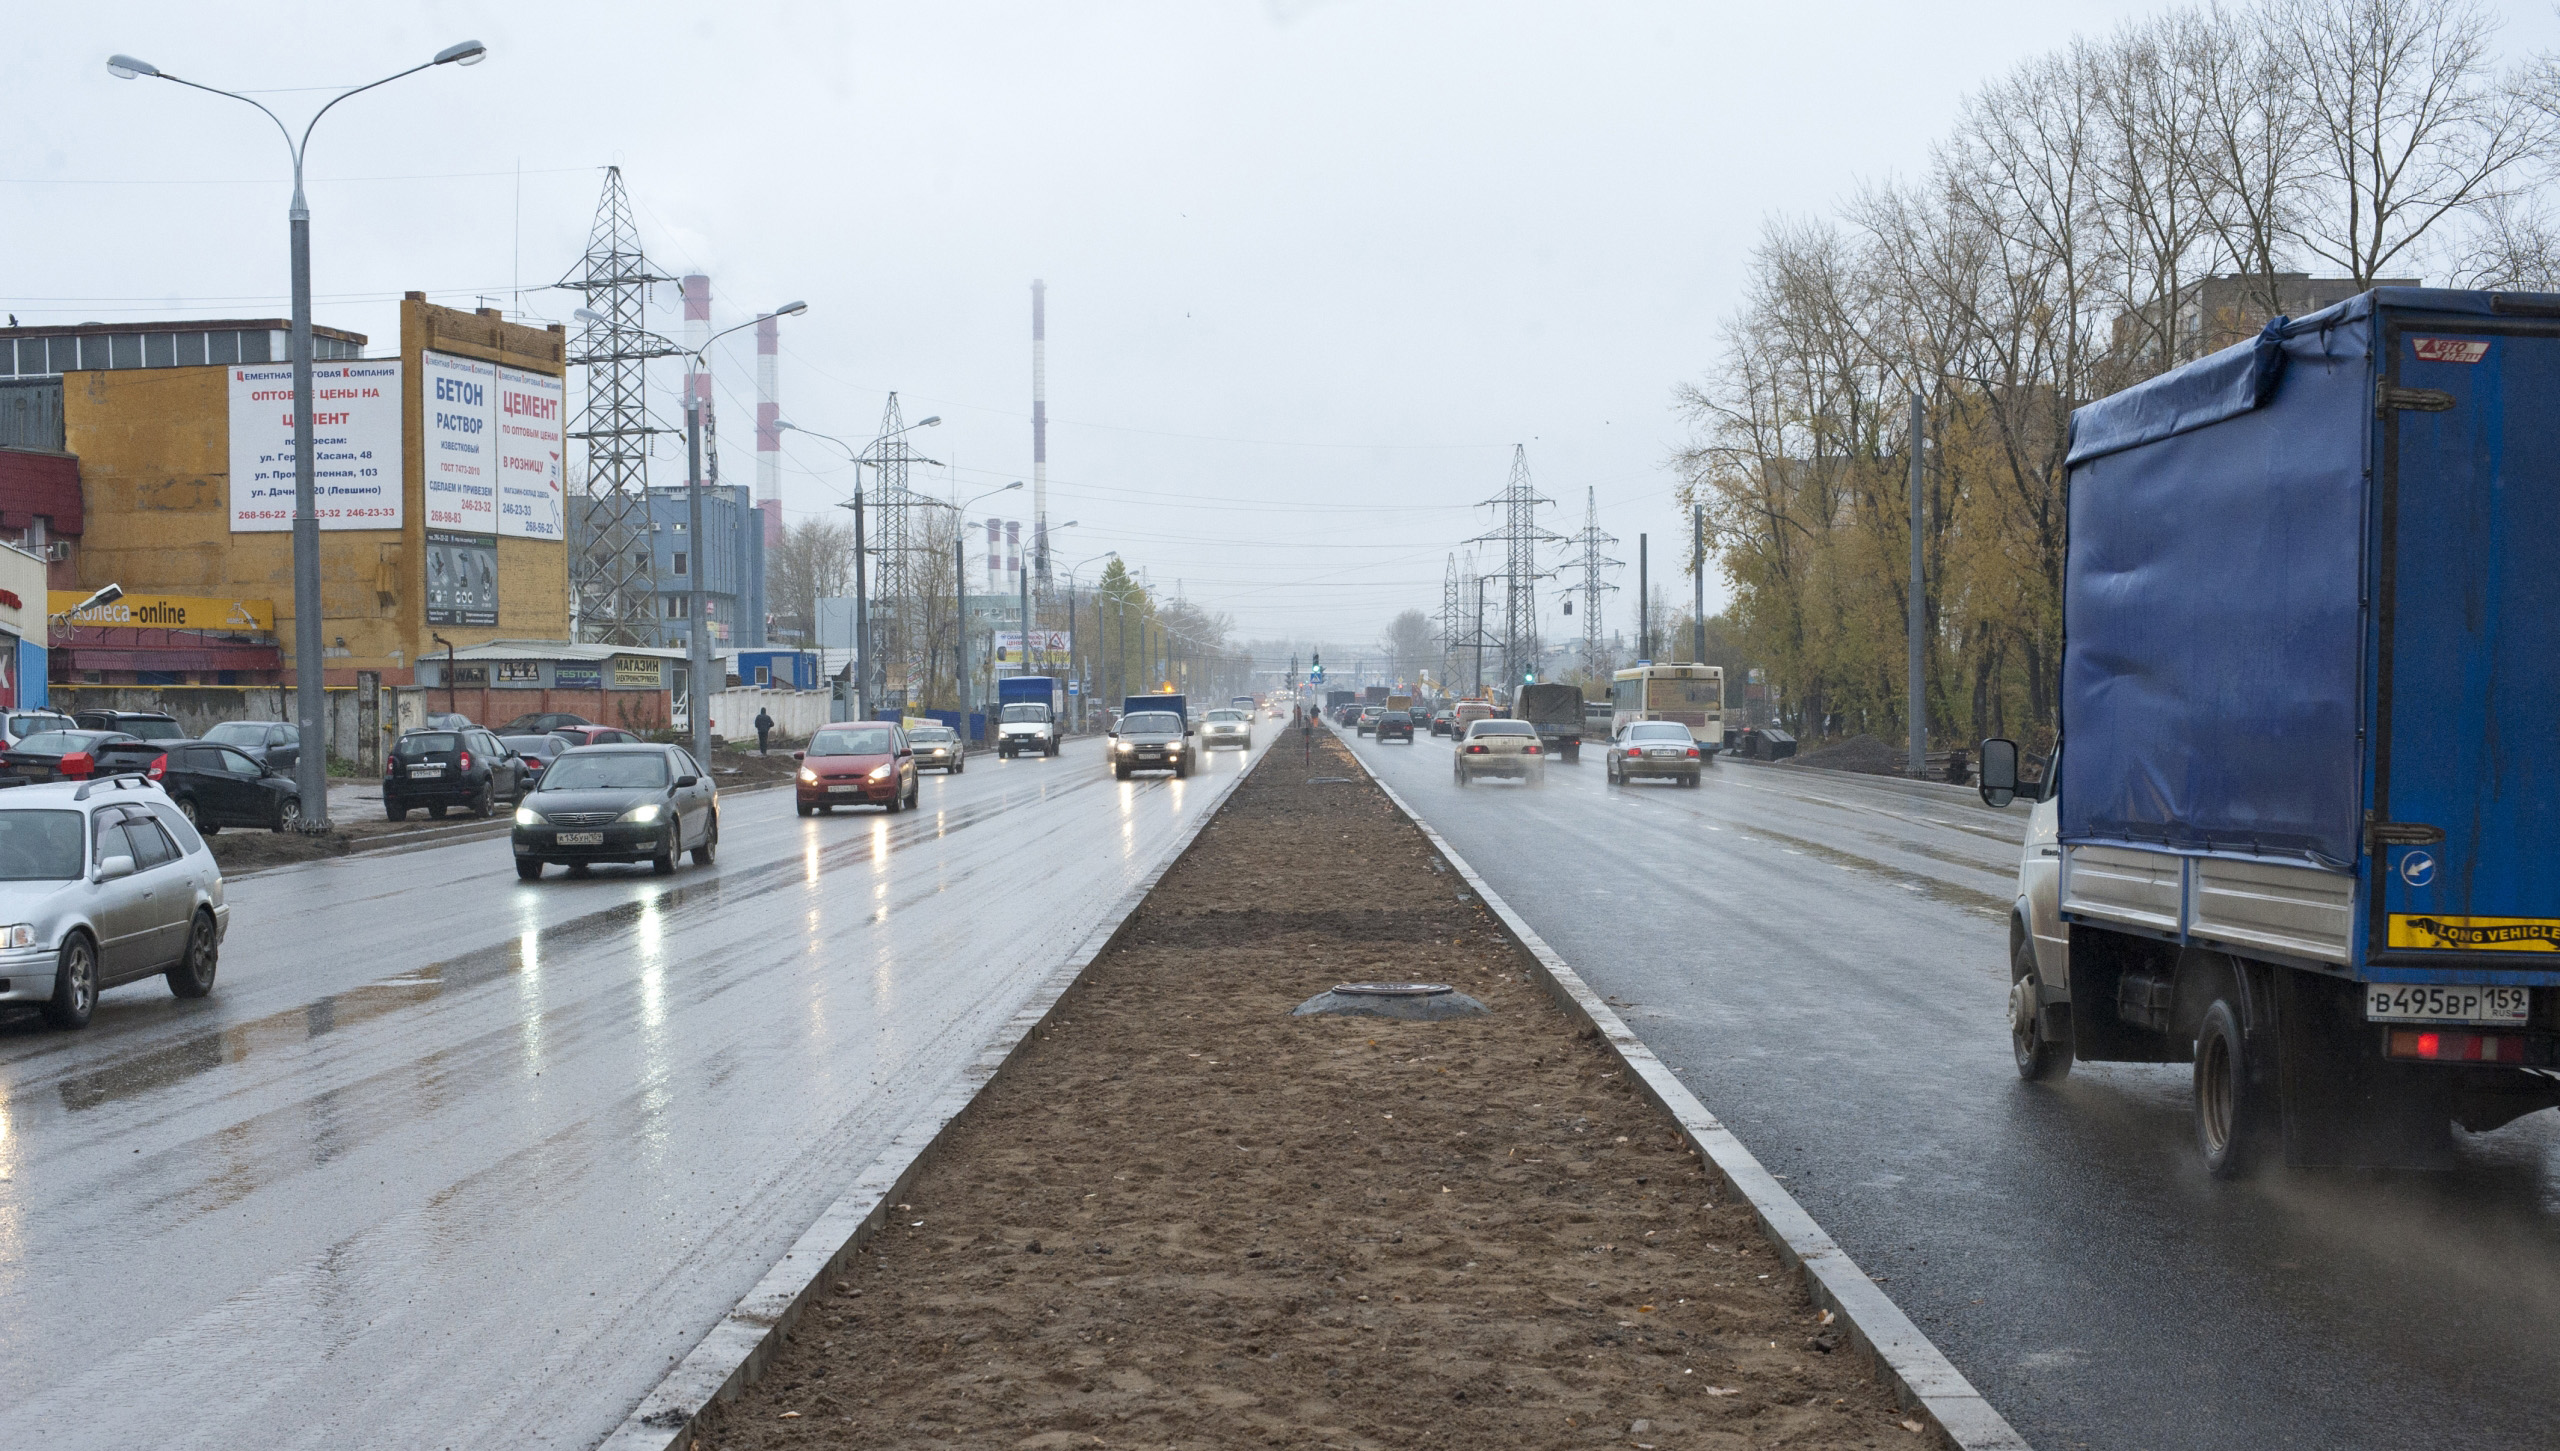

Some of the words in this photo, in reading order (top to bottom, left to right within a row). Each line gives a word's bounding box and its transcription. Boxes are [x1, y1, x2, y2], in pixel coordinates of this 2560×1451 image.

[450, 360, 471, 372] ТОРГОВАЯ
[472, 364, 494, 376] КОМПАНИЯ
[237, 371, 292, 382] ЦЕМЕНТНАЯ
[343, 368, 394, 377] КОМПАНИЯ
[252, 389, 315, 401] ОПТОВ
[320, 389, 357, 400] ЦЕНЫ
[362, 388, 380, 398] НА
[436, 377, 483, 406] БЕТОН
[504, 391, 557, 420] ЦЕМЕНТ
[283, 413, 349, 427] ЦЕНТ
[436, 412, 483, 434] РАСТВОР
[502, 424, 510, 434] ПО
[512, 426, 539, 439] ОПТОВЫМ
[541, 431, 558, 441] ЦЕНАМ
[441, 441, 480, 454] ИЗВЕСТКОВЫЙ
[260, 455, 275, 464] ул.
[316, 452, 357, 461] Хасана,
[360, 451, 372, 459] 48
[441, 463, 454, 472] ГОСТ
[503, 456, 508, 468] В
[510, 457, 543, 474] РОЗНИЦУ
[254, 472, 269, 480] ул.
[360, 468, 378, 477] 103
[251, 489, 266, 498] ул.
[328, 485, 381, 496] (Левшино)
[429, 480, 456, 492] СДЕЛАЕМ
[457, 484, 462, 492] И
[463, 485, 493, 496] ПРИВЕЗЕМ
[504, 487, 536, 498] МАГАЗИН-СКЛАД
[537, 490, 549, 498] ЗДЕСЬ
[461, 499, 491, 512] 246-23-32
[502, 503, 531, 516] 246-23-33
[238, 511, 286, 519] 268-56-22
[347, 508, 394, 517] 246-23-33
[431, 510, 461, 523] 268-98-83
[525, 521, 553, 534] 268-56-22
[616, 659, 659, 672] МАГАЗИН
[556, 670, 600, 678] FESTOOL
[615, 674, 659, 683] ЭЛЕКТРОИНСТРУМЕНТА
[2437, 924, 2483, 942] LONG
[2487, 925, 2560, 942] VEHICLE
[2375, 987, 2478, 1017] В495ВР
[2485, 988, 2524, 1010] 159
[2492, 1009, 2512, 1017] RUS
